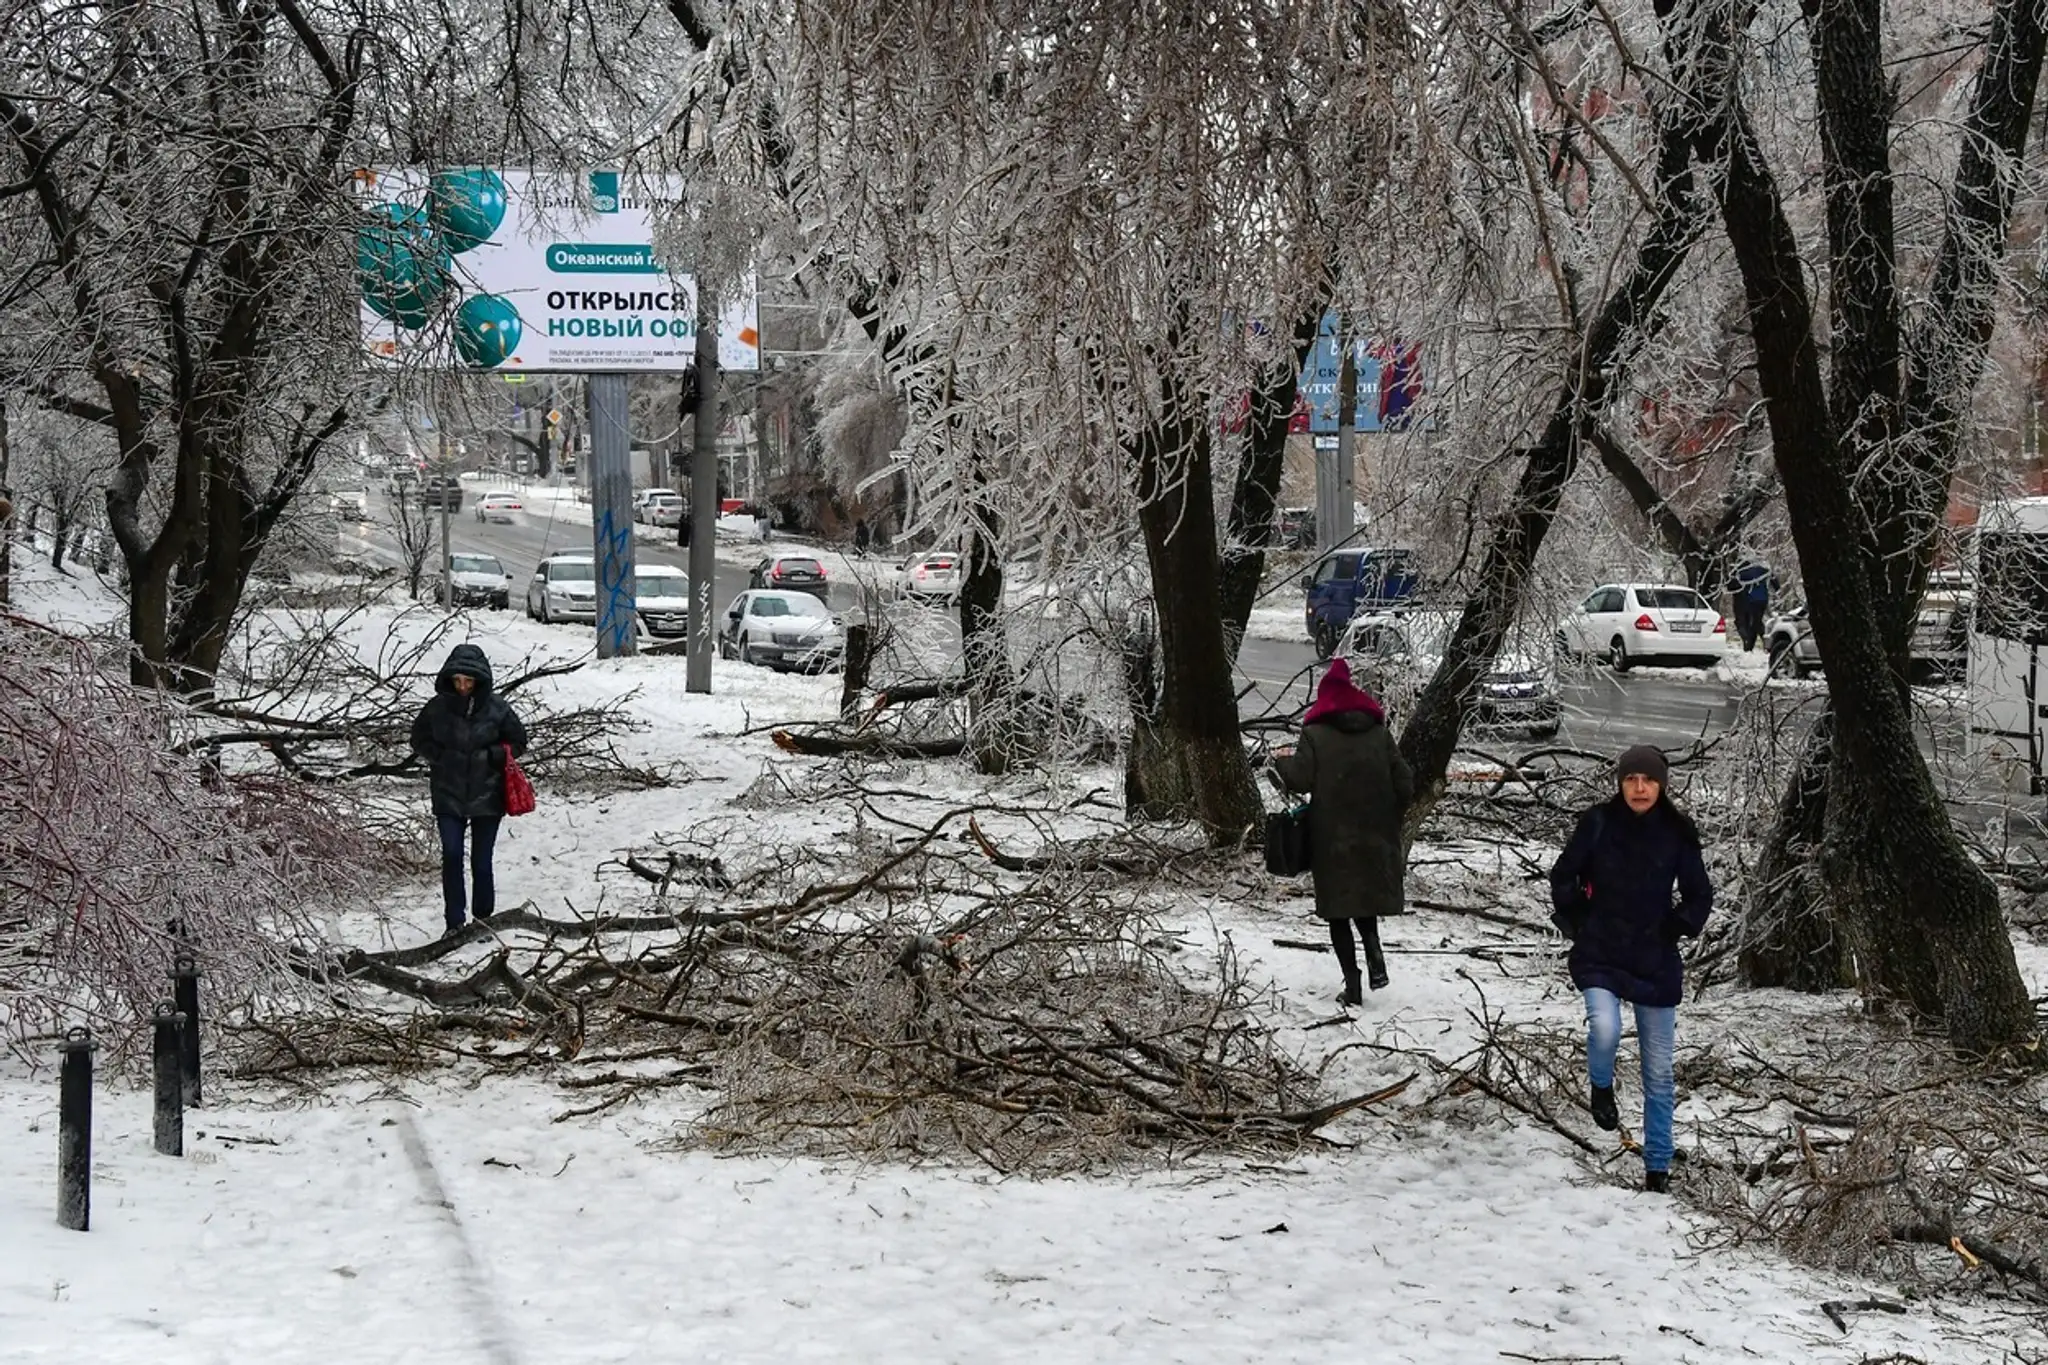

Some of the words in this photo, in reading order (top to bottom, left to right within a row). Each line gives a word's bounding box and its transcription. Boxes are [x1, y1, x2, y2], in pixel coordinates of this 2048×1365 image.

[543, 196, 588, 208] БАН
[555, 250, 644, 265] Океанский
[547, 291, 685, 311] ОТКРЫЛСЯ
[548, 314, 643, 337] НОВЫЙ
[650, 318, 723, 338] ОФ
